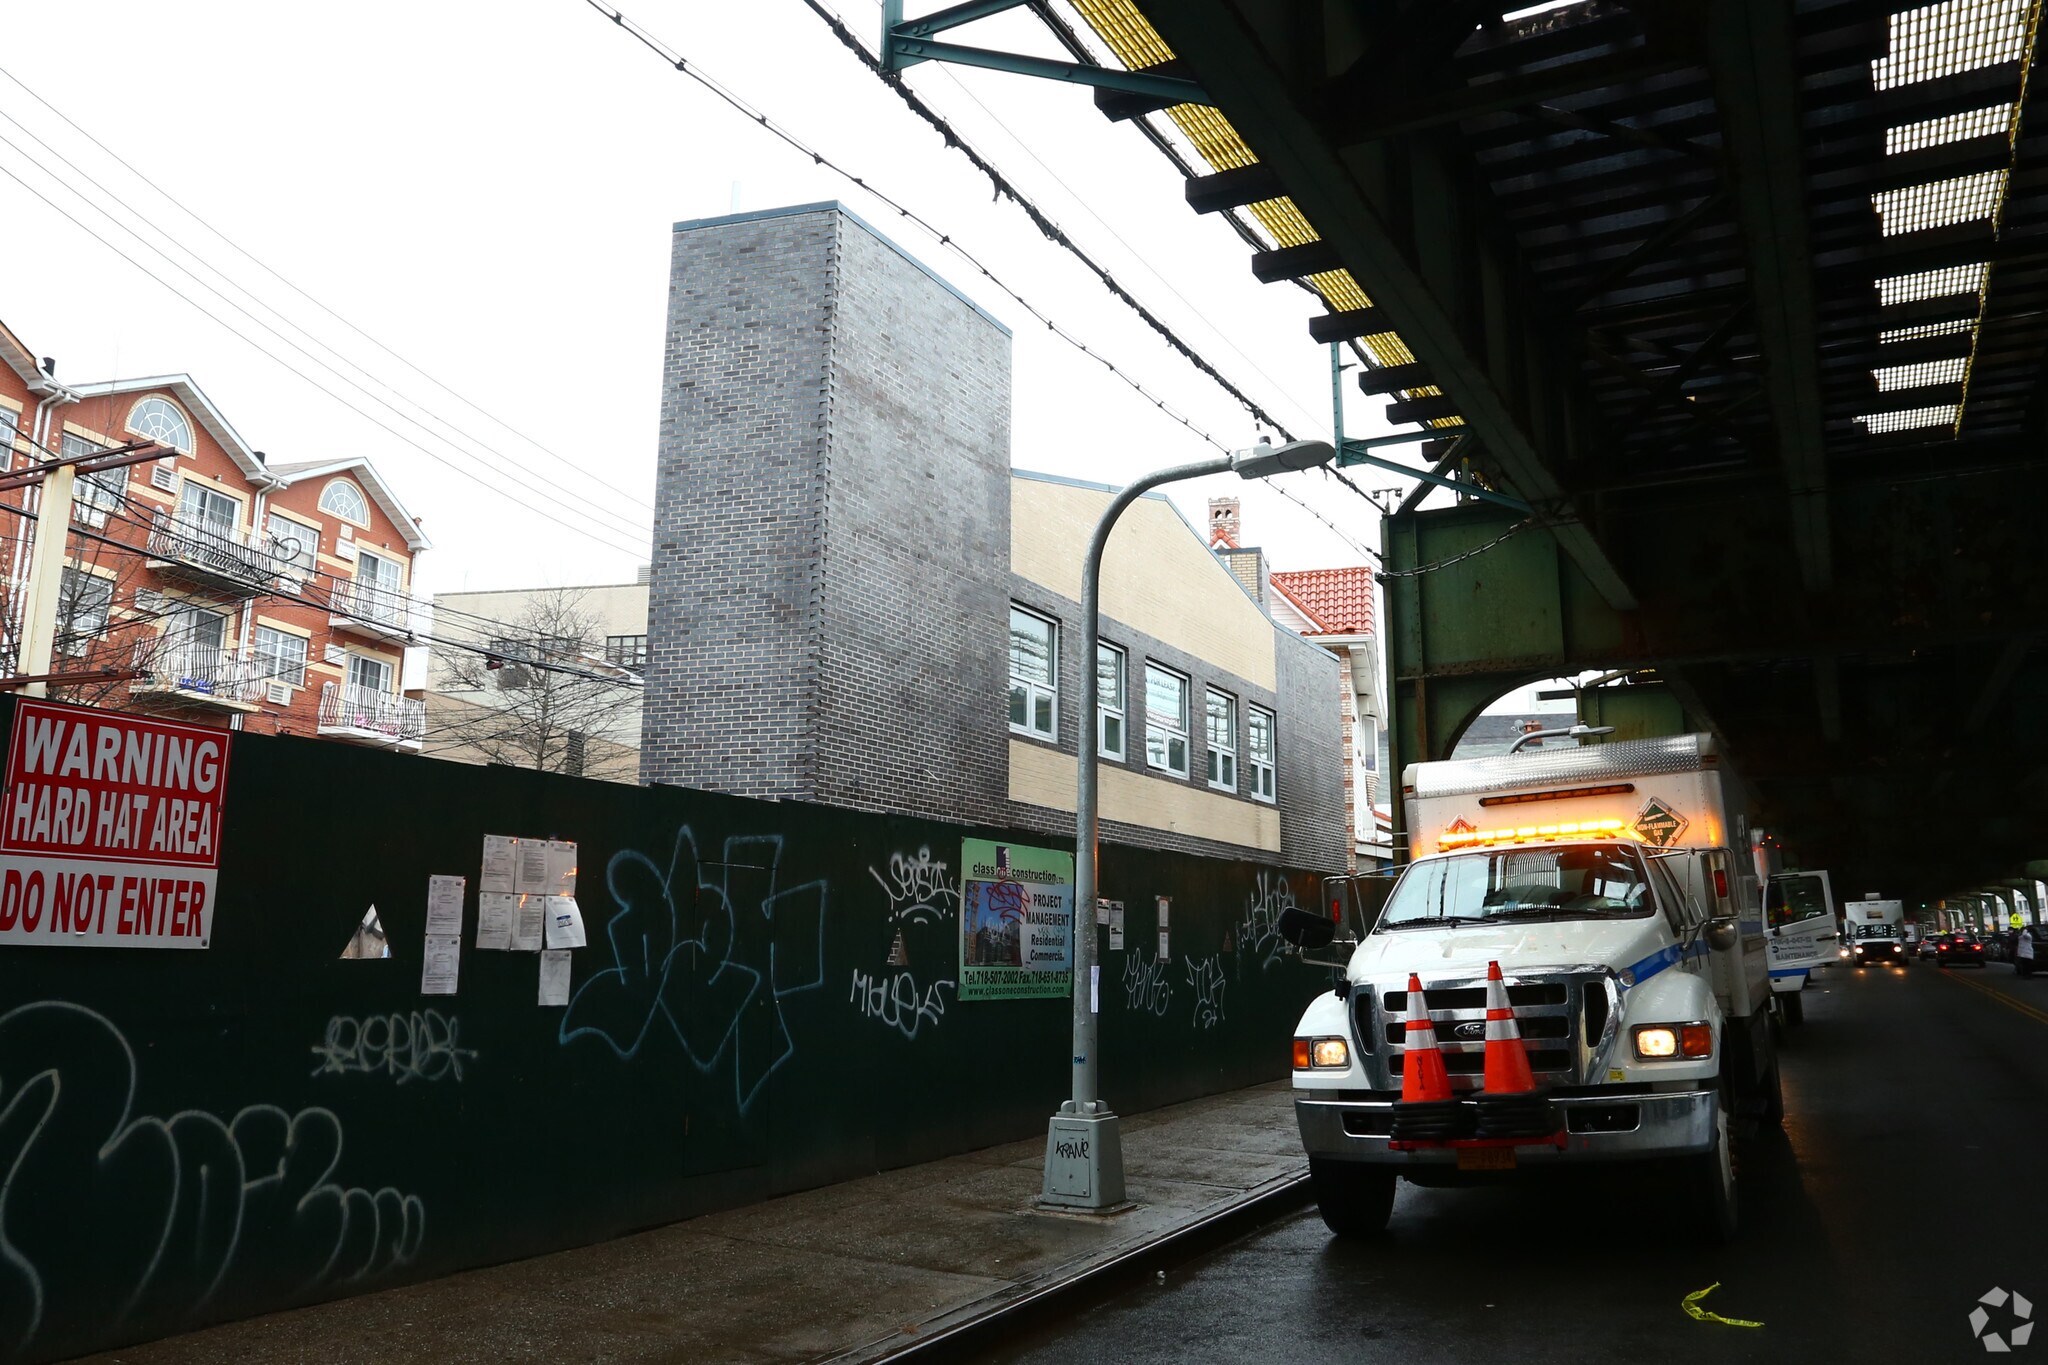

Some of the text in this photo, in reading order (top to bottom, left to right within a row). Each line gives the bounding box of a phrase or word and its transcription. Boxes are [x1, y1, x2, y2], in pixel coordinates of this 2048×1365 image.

[24, 715, 219, 793] WARNING
[11, 782, 212, 855] HARD HAT AREA
[1636, 820, 1677, 831] NON-FLAMMABLE
[972, 862, 995, 875] class
[1011, 867, 1057, 882] construction
[0, 869, 206, 937] DO NOT ENTER
[1033, 894, 1062, 908] PROJECT
[1026, 911, 1070, 926] MANAGEMENT
[1031, 934, 1065, 946] Residential
[968, 983, 1065, 996] www.classoneconstruction.com
